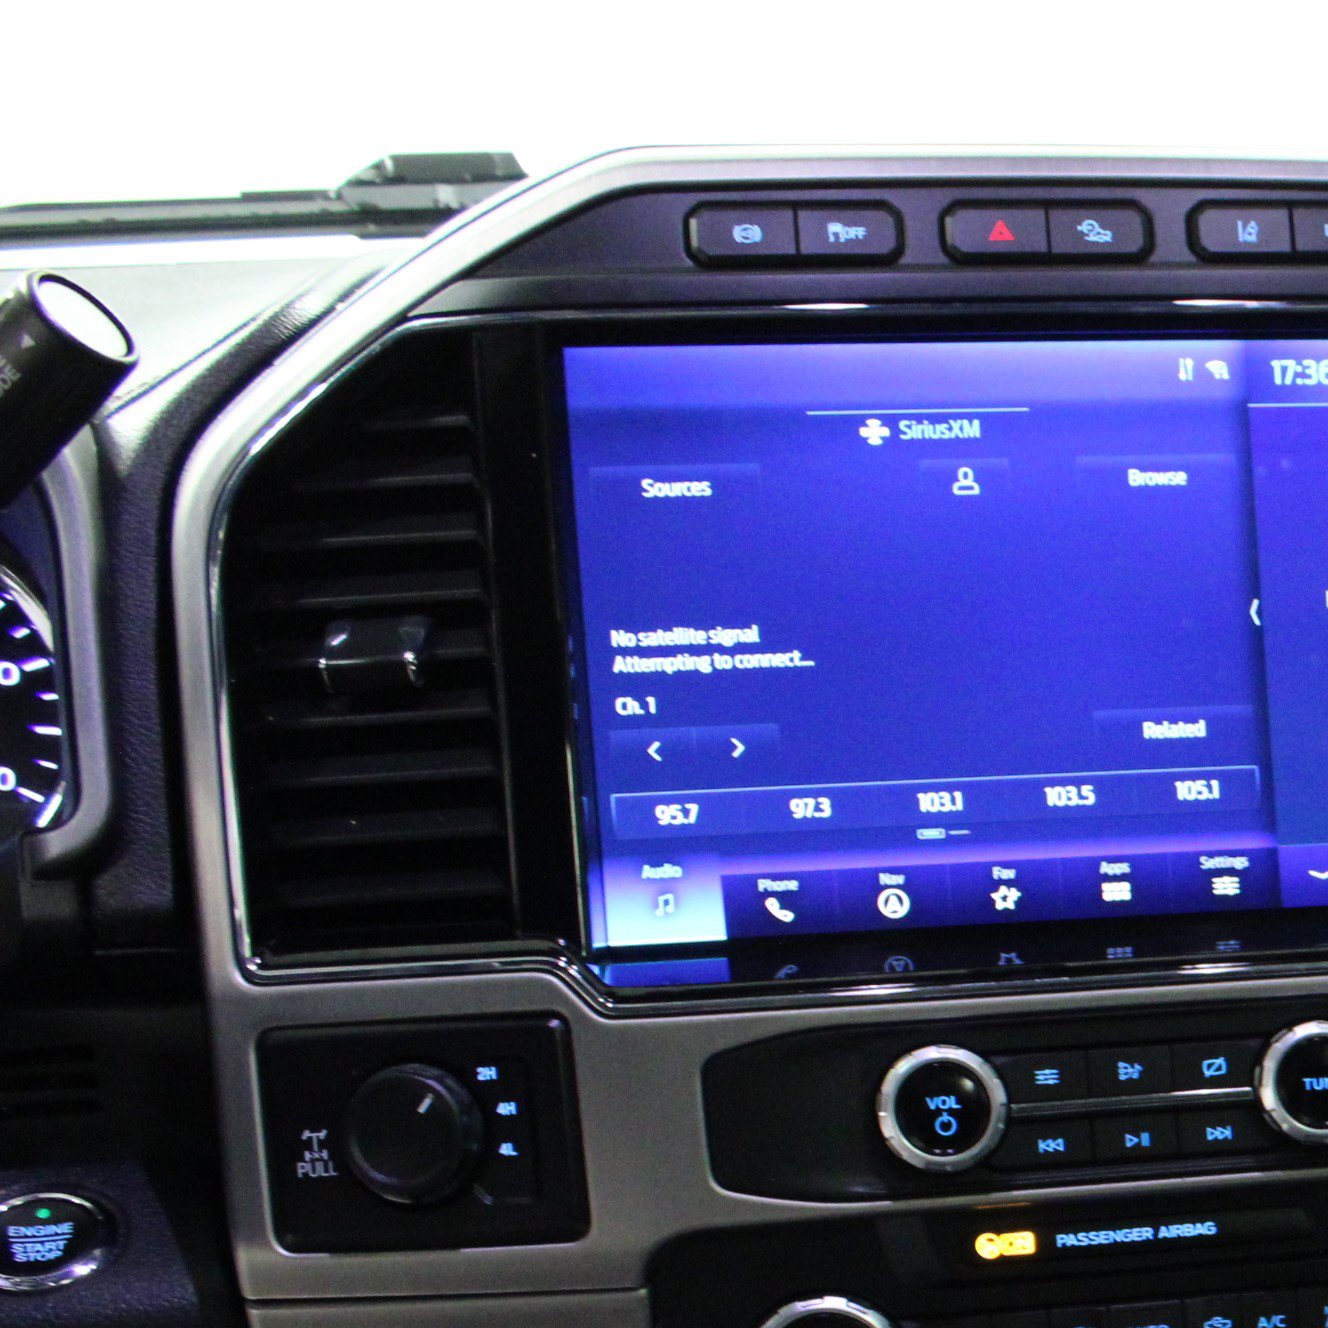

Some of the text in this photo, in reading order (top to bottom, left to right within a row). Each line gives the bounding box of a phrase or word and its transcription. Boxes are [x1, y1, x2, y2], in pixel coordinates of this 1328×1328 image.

[899, 419, 981, 439] SiriusXM
[641, 478, 712, 497] Sources
[1128, 469, 1187, 486] Browse
[610, 624, 760, 647] No satellite signal
[612, 653, 712, 674] Attempting
[713, 653, 733, 669] to
[615, 696, 656, 716] Ch. 1
[1142, 720, 1207, 740] Related
[655, 779, 1220, 826] 95.7 97.3 103.1 103.5 105.1
[641, 855, 1249, 893] Audio Phone Nav Fav Apps Settings
[926, 1095, 961, 1110] VOL
[296, 1161, 338, 1178] PULL
[7, 1222, 74, 1237] ENGINE
[1056, 1220, 1217, 1248] PASSENGER AIRBAG
[11, 1240, 68, 1253] START
[13, 1251, 63, 1262] STOP
